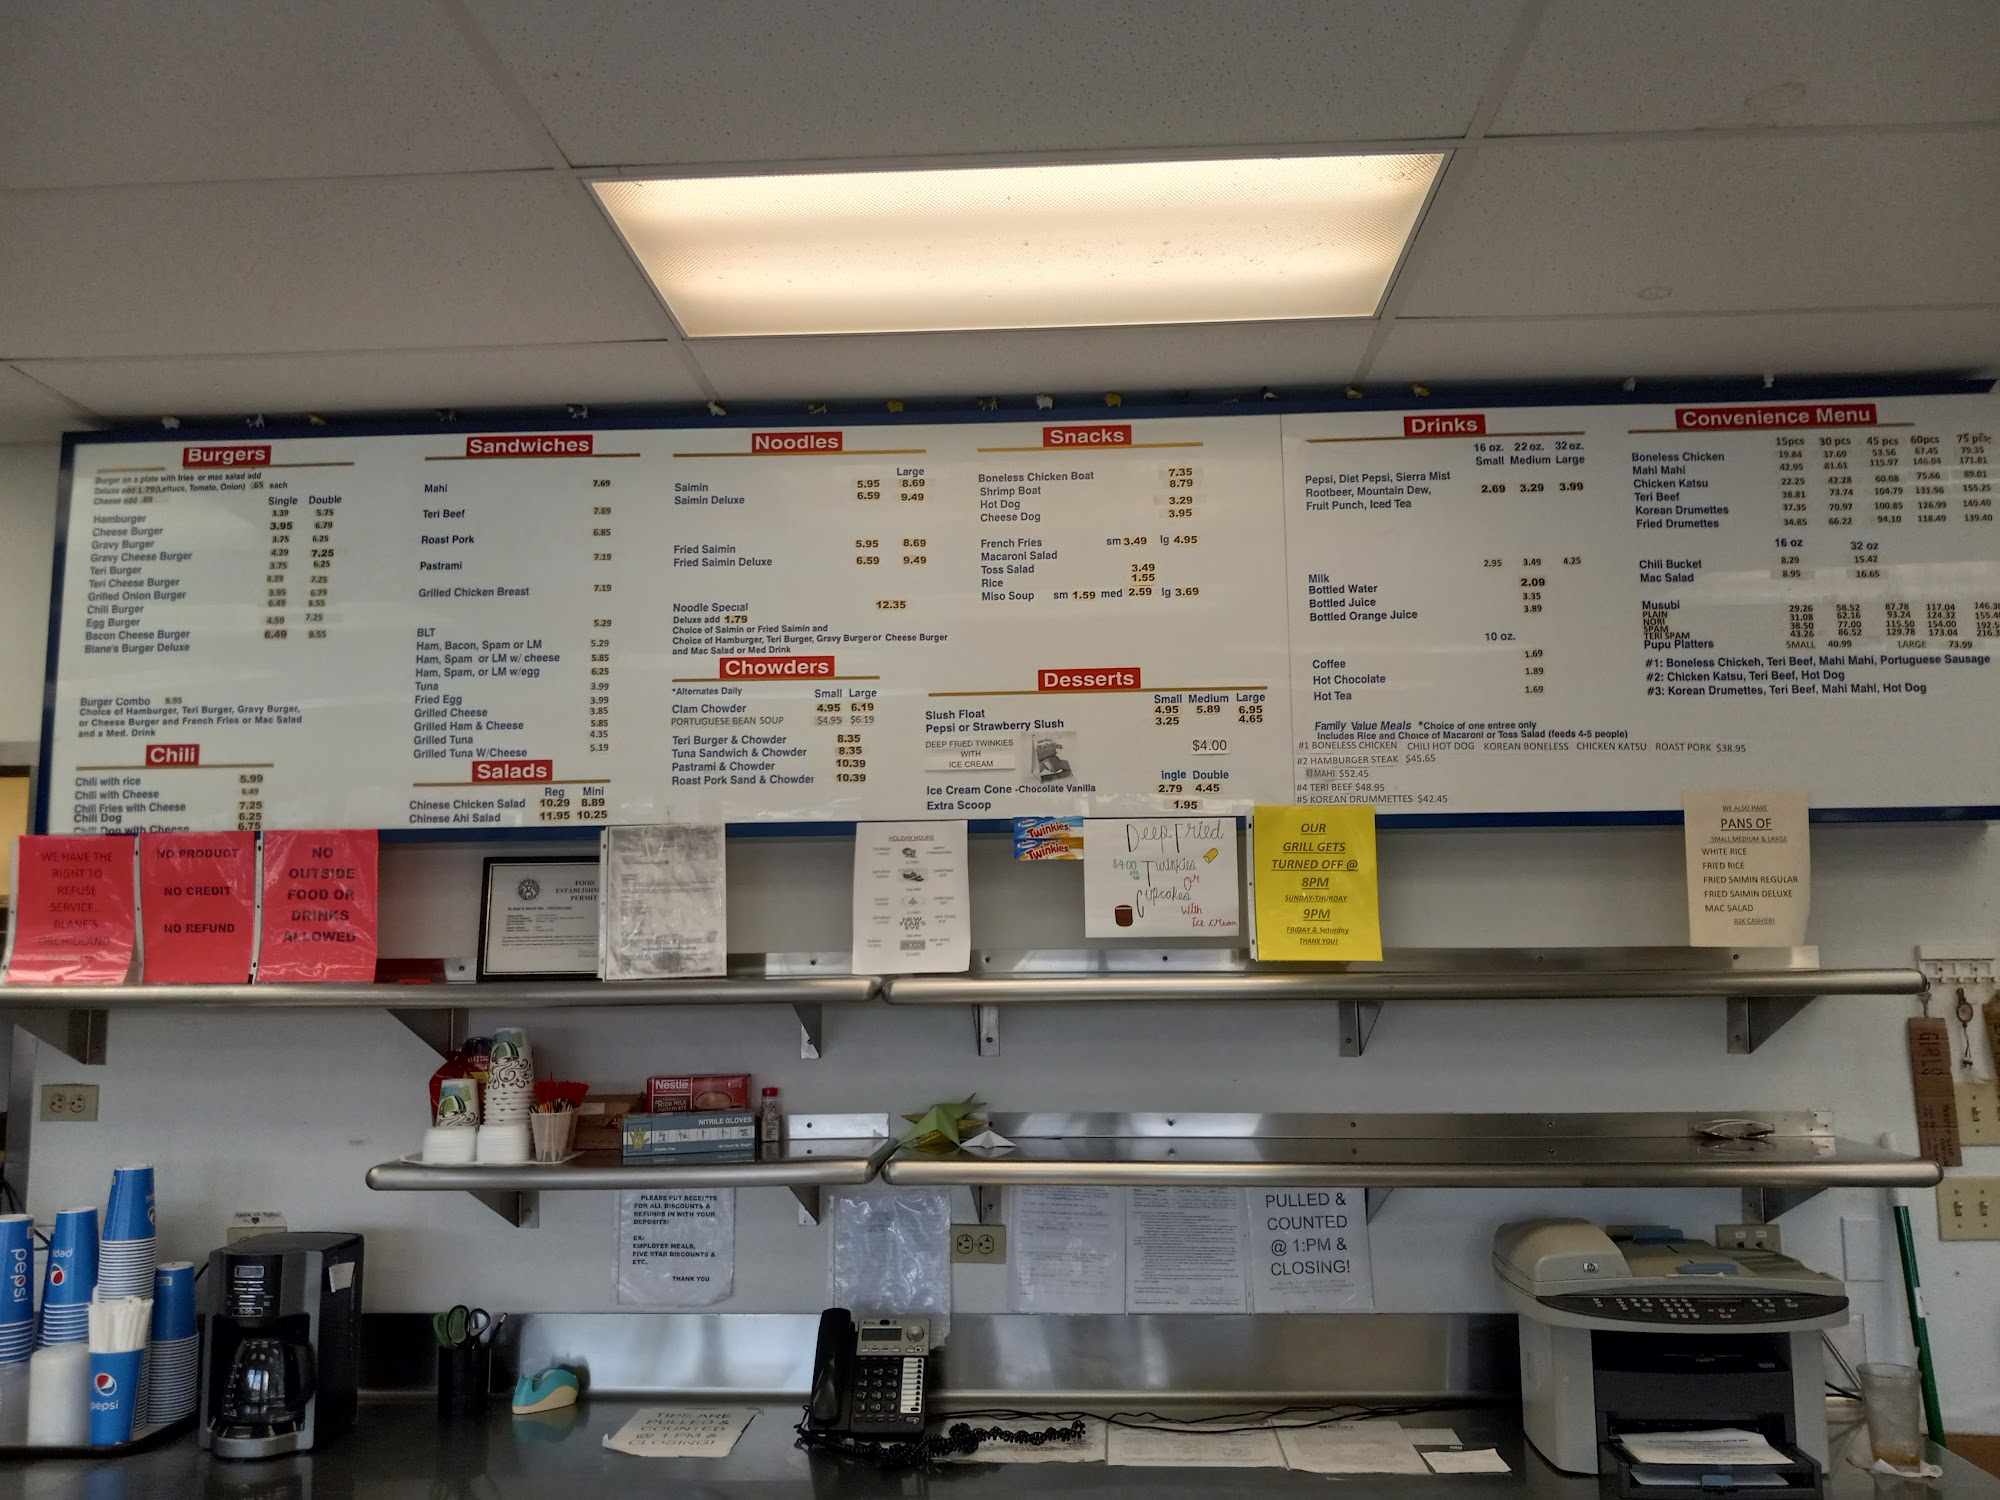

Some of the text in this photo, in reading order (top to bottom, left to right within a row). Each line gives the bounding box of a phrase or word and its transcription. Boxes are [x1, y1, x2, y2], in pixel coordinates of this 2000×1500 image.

[1682, 408, 1870, 427] Convenience Menu
[1411, 419, 1478, 433] Drinks
[755, 435, 839, 449] Noodles
[1050, 430, 1125, 444] Snacks
[470, 438, 590, 454] Sandwiches
[188, 447, 266, 464] Burgers
[1476, 454, 1586, 466] Small Medium Large
[978, 467, 1193, 483] Boneless Chicken Boat 7.35
[1306, 471, 1451, 485] Pepsi, Diet Pepsi, Sierra Mist
[424, 479, 611, 493] Mahi 7.69
[674, 478, 926, 492] Saimin 5.95 8.69
[1481, 482, 1584, 493] 2.69 3.29 3.99
[268, 494, 343, 506] Single Double
[423, 509, 466, 518] Teri Beef
[981, 512, 1042, 522] Cheese Dog
[270, 521, 293, 530] 3.95
[981, 535, 1198, 548] French Fries sm 3.49 lg 4.95
[91, 548, 335, 563] Gravy Cheese Burger 7.25
[420, 552, 612, 571] Pastrami 7.19
[1521, 577, 1546, 586] 2.09
[1640, 572, 1695, 582] Mac Salad
[982, 591, 1035, 601] Miso Soup
[673, 600, 907, 612] Noodle Special 12.35
[1644, 639, 1714, 651] Pupu Platters
[725, 660, 829, 675] Chowders
[1312, 659, 1347, 669] Coffee
[1045, 673, 1134, 687] Desserts
[1313, 674, 1385, 685] Hot Chocolate
[415, 695, 462, 705] Fried Egg
[925, 709, 985, 719] Slush Float
[672, 716, 785, 726] PORTUGUESE BEAN SOUP
[1315, 720, 1412, 732] Family Value Meals
[925, 738, 1014, 748] DEEP FRIED TWINKIES
[1192, 740, 1227, 751] $4.00
[150, 748, 195, 762] Chili
[1405, 754, 1436, 764] $45.65
[477, 764, 547, 779] Salads
[672, 761, 776, 772] Pastrami & Chowder
[240, 773, 264, 783] 5.99
[409, 798, 606, 810] Chinese Chicken Salad 10.29 8.89
[927, 800, 1198, 812] Extra Scoop 1.95
[74, 813, 122, 824] Chili Dog
[1721, 818, 1772, 828] PANS OF
[1027, 823, 1069, 838] Twinkies
[1301, 823, 1326, 833] OUR
[889, 834, 935, 842] HOLIDAY HOURS
[1126, 819, 1224, 854] Deep Fried
[1026, 845, 1069, 860] Twinkies
[1283, 842, 1345, 852] GRILL GETS
[1702, 847, 1748, 856] WHITE RICE
[157, 848, 240, 858] NO PRODUCT
[312, 848, 333, 858] NO
[1272, 859, 1358, 871] TURNED OFF @
[53, 868, 103, 878] RIGHT TO
[289, 869, 354, 879] OUTSIDE
[1141, 858, 1197, 887] Twinkies
[1302, 877, 1329, 888] 8PM
[58, 885, 97, 895] REFUSE
[164, 886, 230, 896] NO CREDIT
[287, 889, 355, 900] FOOD OR
[1137, 887, 1191, 918] Cupcakes
[1303, 909, 1330, 919] 9PM
[1705, 904, 1754, 913] MAC SALAD
[291, 910, 348, 921] DRINKS
[164, 923, 234, 933] NO REFUND
[283, 931, 356, 942] ALLOWED
[699, 1116, 753, 1126] NITRILE GLOVES
[1265, 1193, 1346, 1207] PULLED &
[1267, 1216, 1347, 1230] COUNTED
[1271, 1238, 1347, 1256] @ 1:PM &
[1271, 1260, 1350, 1276] CLOSING!
[11, 1248, 28, 1302] pepsi
[90, 1400, 118, 1411] pepsi
